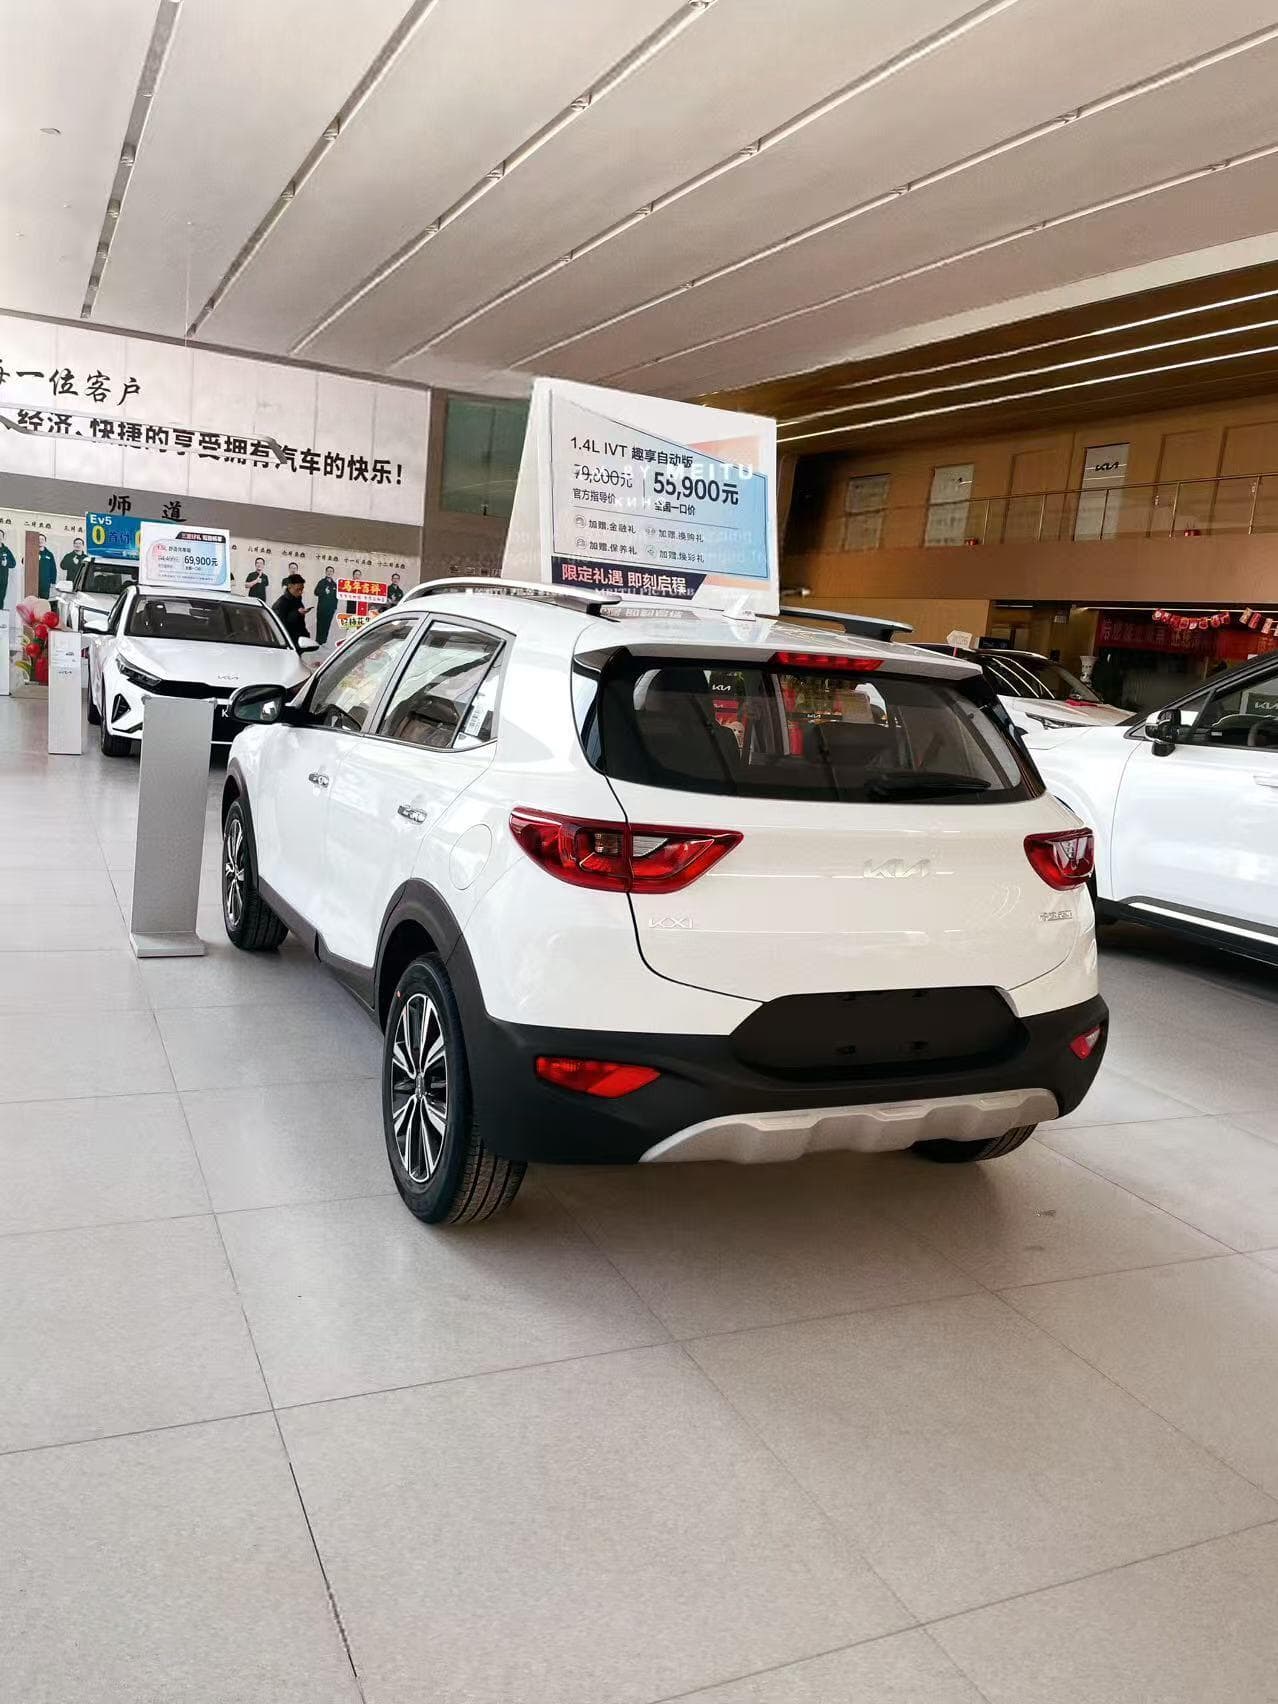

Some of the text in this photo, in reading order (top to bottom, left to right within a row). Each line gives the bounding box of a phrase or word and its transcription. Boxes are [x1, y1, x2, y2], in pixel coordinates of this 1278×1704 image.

[570, 436, 693, 469] 1.4L IVT 趣享自动版
[572, 487, 617, 505] 官方指导价
[653, 471, 739, 505] 55,900元
[184, 554, 219, 568] 69,900元
[561, 562, 688, 595] 限定礼遇 即刻启程
